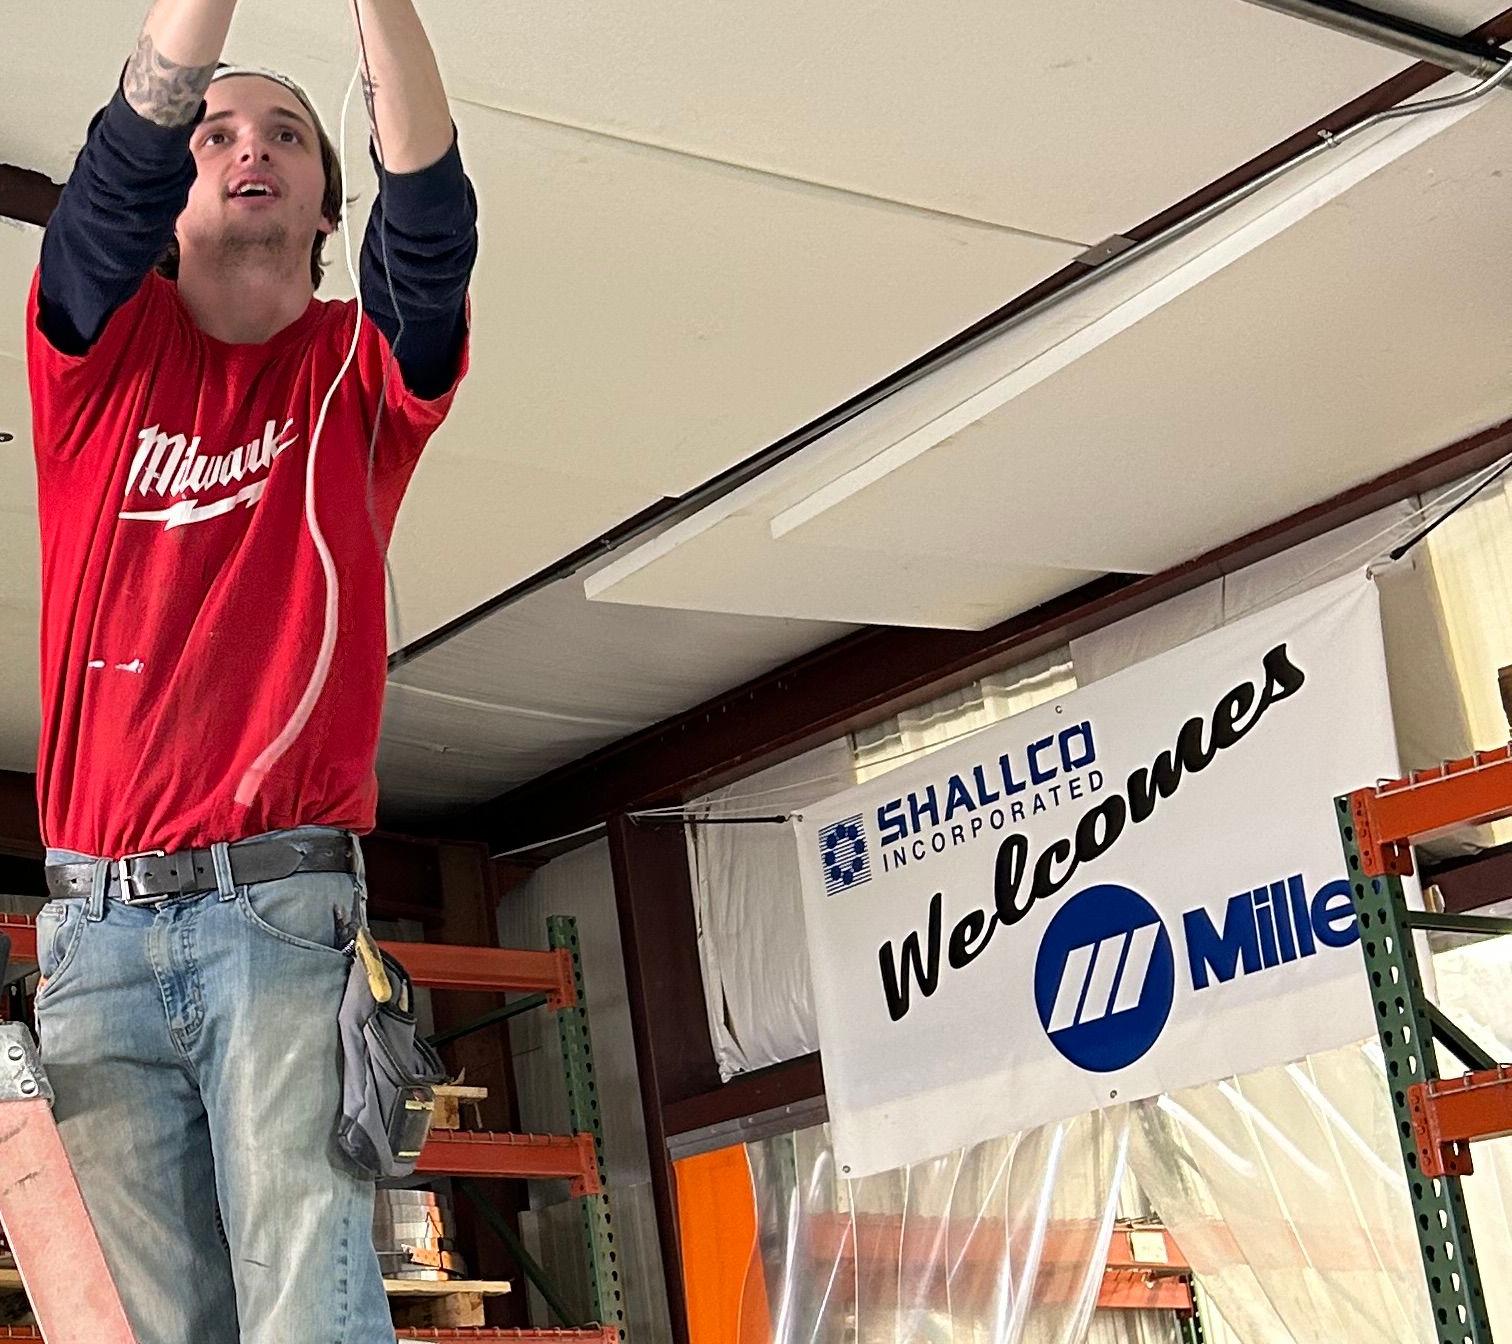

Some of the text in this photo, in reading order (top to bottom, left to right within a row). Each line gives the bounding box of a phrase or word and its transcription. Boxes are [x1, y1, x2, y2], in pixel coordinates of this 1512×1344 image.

[876, 720, 1097, 848] SHALLCO
[878, 642, 1306, 1023] Welcomes
[882, 769, 1104, 873] INCORPORATED
[1182, 872, 1361, 992] Mille
